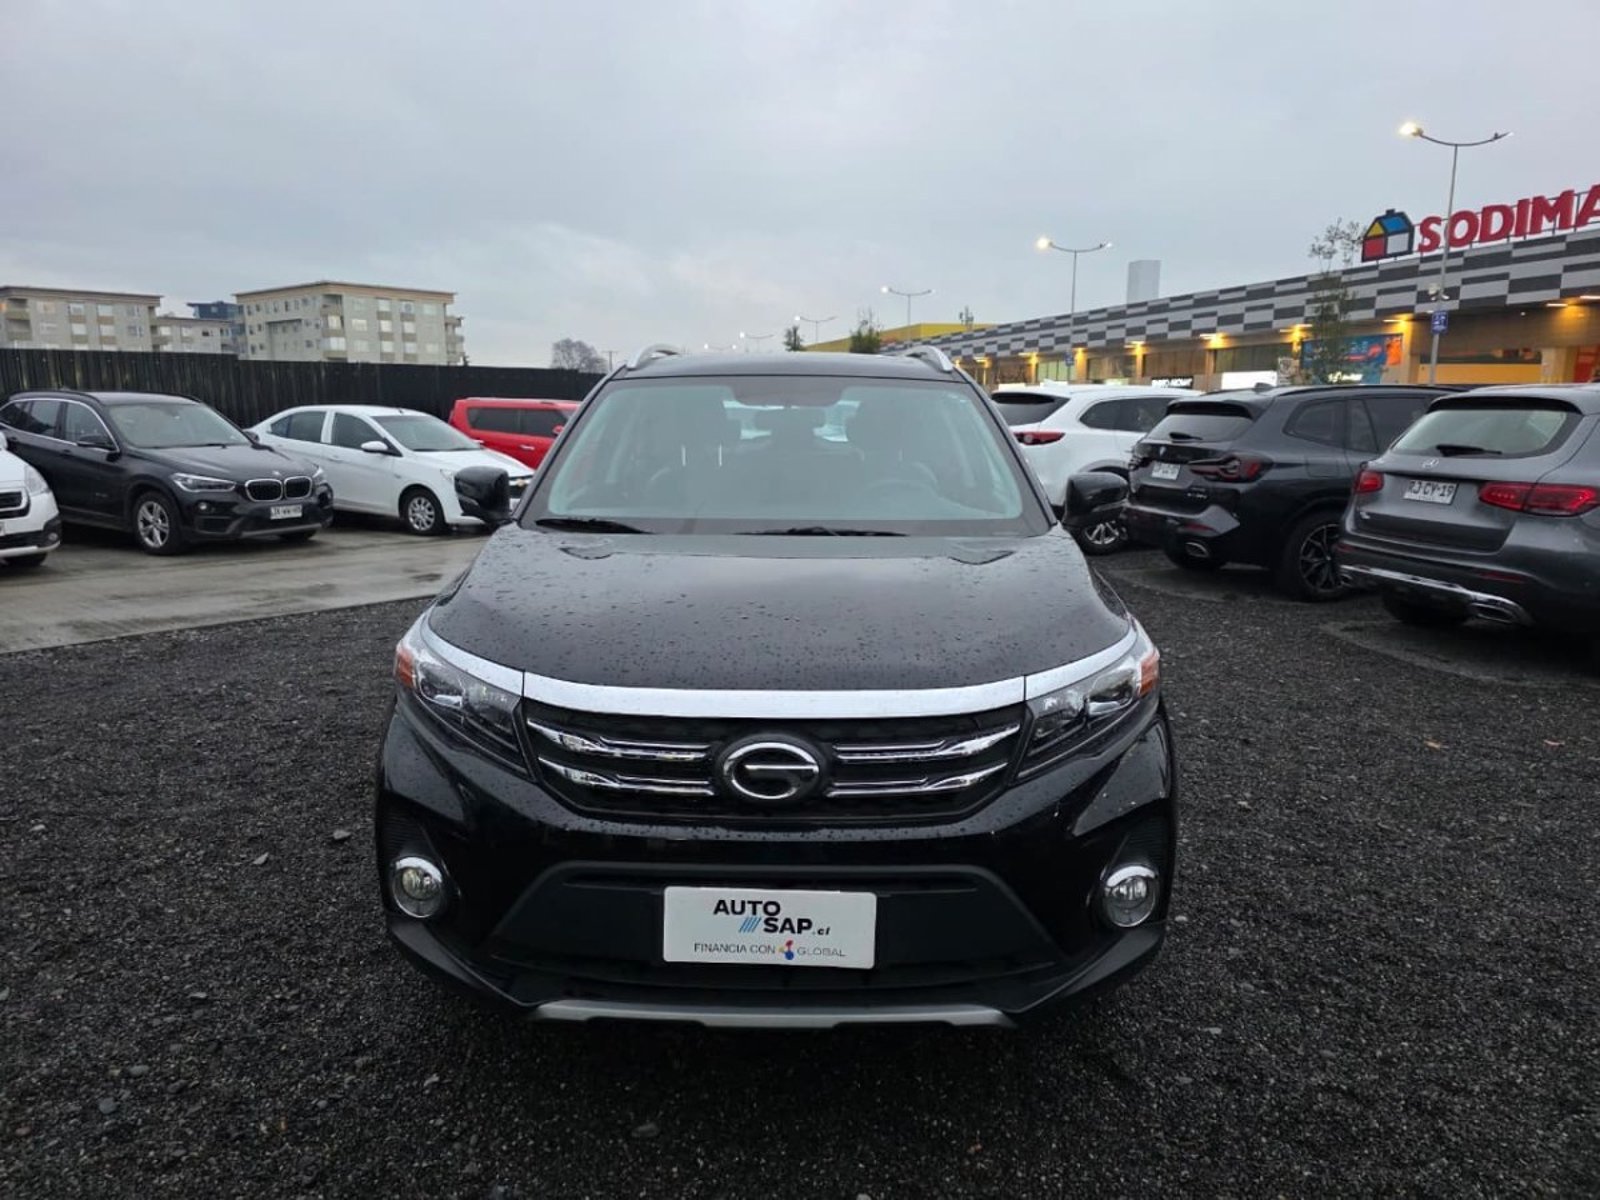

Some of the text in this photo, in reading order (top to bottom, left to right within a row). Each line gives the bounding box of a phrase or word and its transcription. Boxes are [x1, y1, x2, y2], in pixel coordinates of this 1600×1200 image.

[713, 899, 781, 916] AUTO
[694, 943, 848, 957] FINANCIA CON GLOBAL
